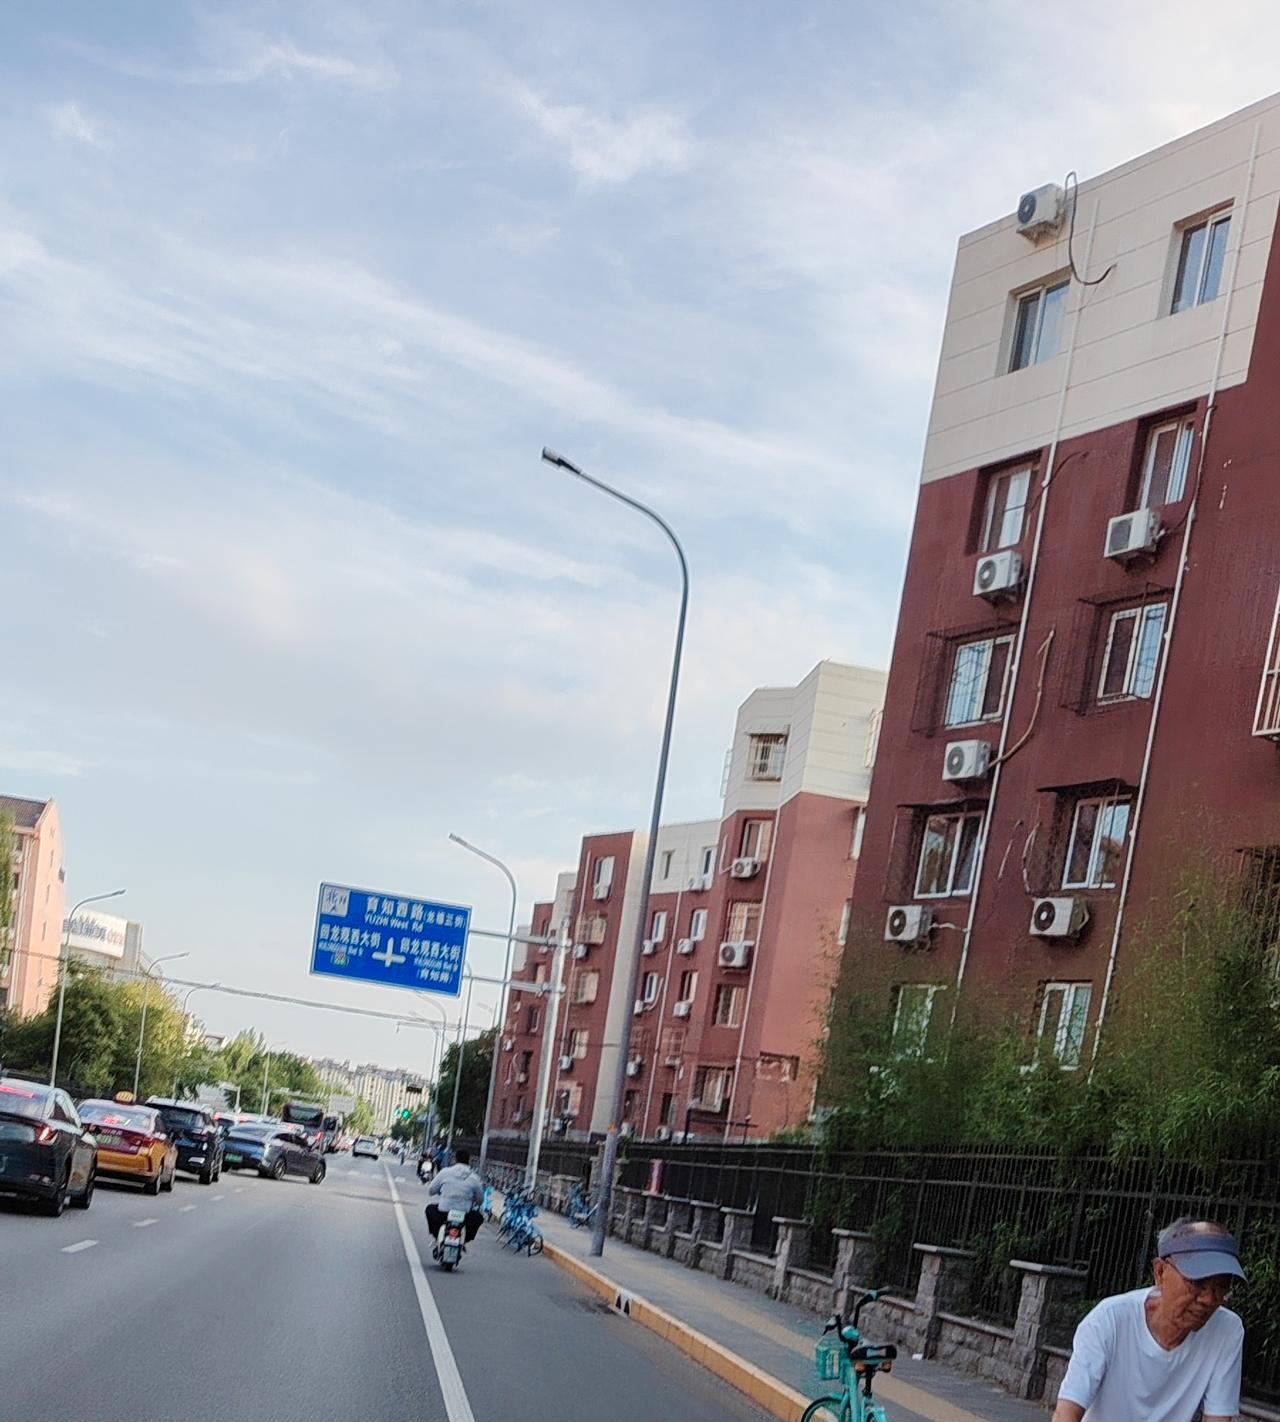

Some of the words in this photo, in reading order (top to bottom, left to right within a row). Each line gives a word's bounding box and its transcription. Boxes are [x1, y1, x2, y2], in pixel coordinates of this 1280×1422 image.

[366, 896, 425, 922] 育知西路
[319, 923, 382, 949] 回龙观西大街
[399, 936, 461, 962] 回龙观西大街
